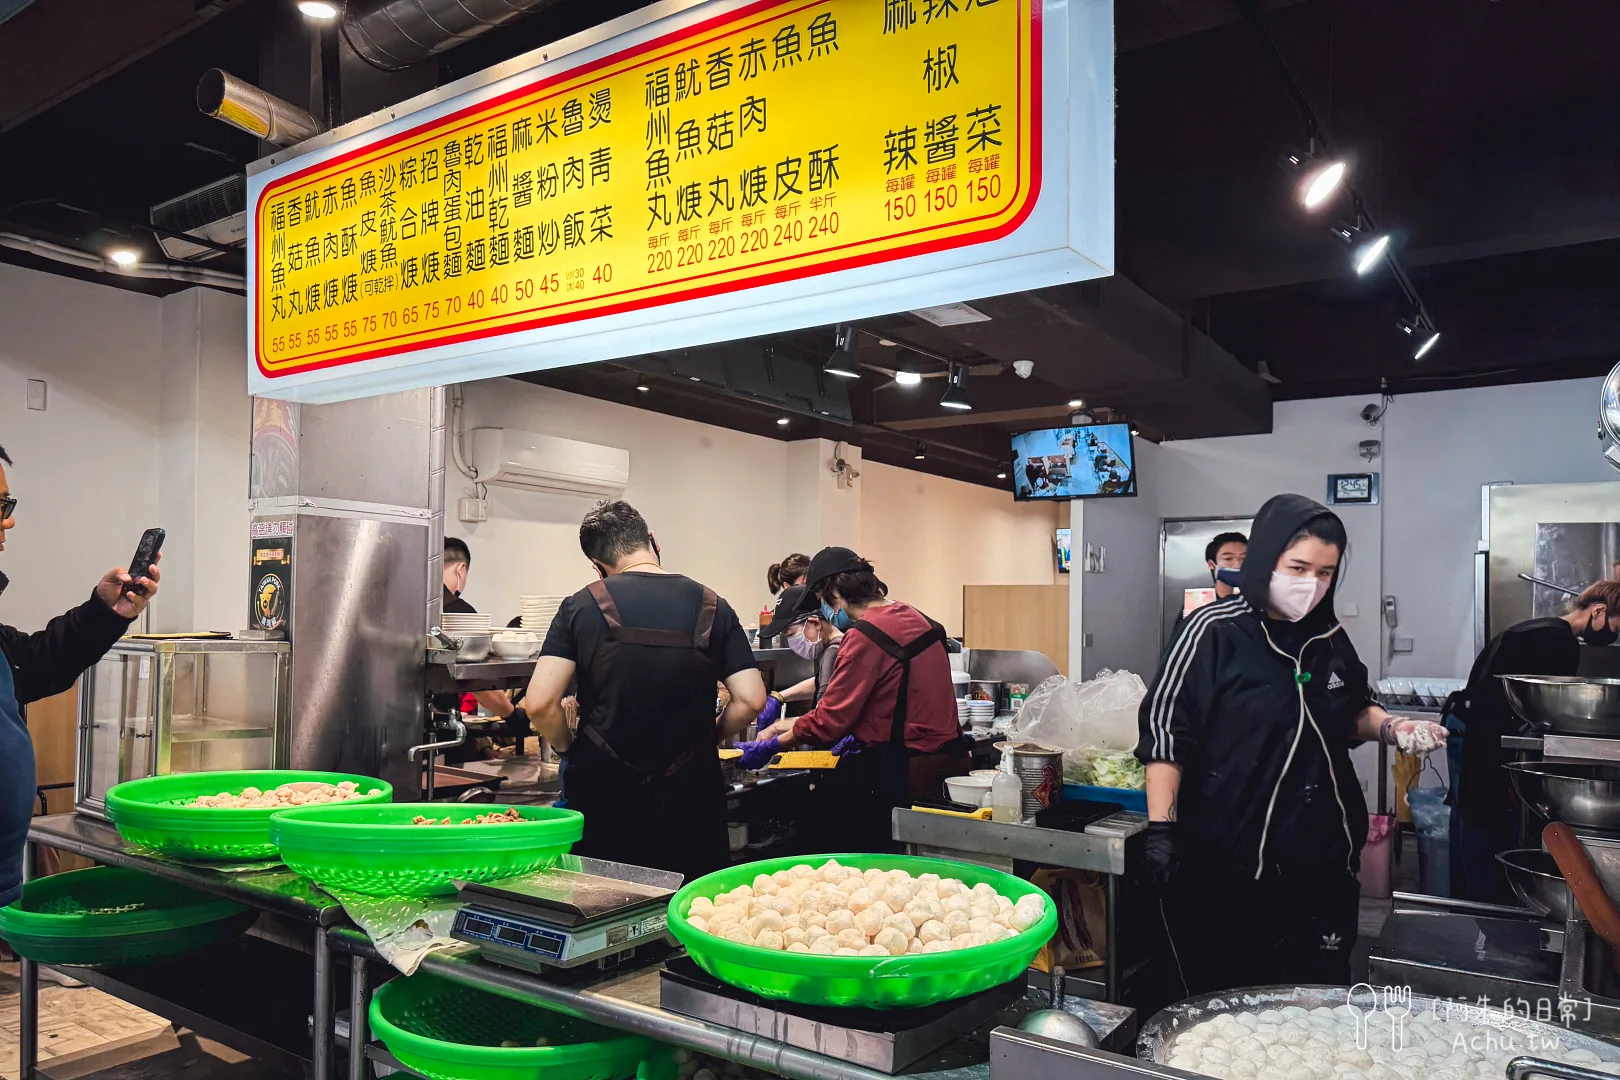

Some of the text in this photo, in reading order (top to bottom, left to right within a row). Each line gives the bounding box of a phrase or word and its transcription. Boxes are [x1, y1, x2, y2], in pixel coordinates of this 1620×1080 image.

[705, 47, 735, 217] 香菇丸
[645, 66, 671, 232] 福州魚丸
[561, 98, 586, 250] 魯肉飯
[588, 87, 614, 243] 燙青菜
[925, 164, 957, 184] 每罐
[967, 154, 1000, 173] 每罐
[512, 117, 535, 263] 麻醬麵
[535, 107, 560, 256] 米粉炒
[885, 174, 915, 193] 每罐
[966, 174, 1001, 203] 150
[464, 133, 486, 275] 乾油麵
[488, 123, 510, 269] 福州乾麵
[810, 192, 838, 210] 半斤
[924, 184, 957, 213] 150
[443, 139, 462, 280] 魯肉蛋包麵
[741, 209, 766, 228] 每斤
[775, 201, 802, 220] 每斤
[884, 194, 916, 222] 150
[677, 225, 701, 243] 每斤
[708, 216, 733, 236] 每斤
[774, 220, 803, 246] 240
[808, 212, 839, 239] 240
[648, 233, 670, 250] 每斤
[708, 236, 735, 261] 220
[740, 228, 768, 254] 220
[271, 201, 286, 322] 福州魚丸
[287, 196, 303, 319] 香菇丸
[648, 250, 672, 274] 220
[677, 243, 703, 268] 220
[540, 272, 559, 294] 45
[592, 263, 613, 284] 40
[490, 284, 508, 305] 40
[515, 278, 534, 300] 50
[424, 301, 440, 320] 75
[445, 296, 462, 316] 70
[468, 290, 485, 310] 40
[363, 315, 377, 333] 75
[383, 310, 397, 329] 70
[402, 305, 419, 325] 65
[307, 328, 320, 346] 55
[325, 324, 338, 341] 55
[343, 319, 357, 338] 55
[272, 336, 285, 353] 55
[288, 332, 302, 350] 55
